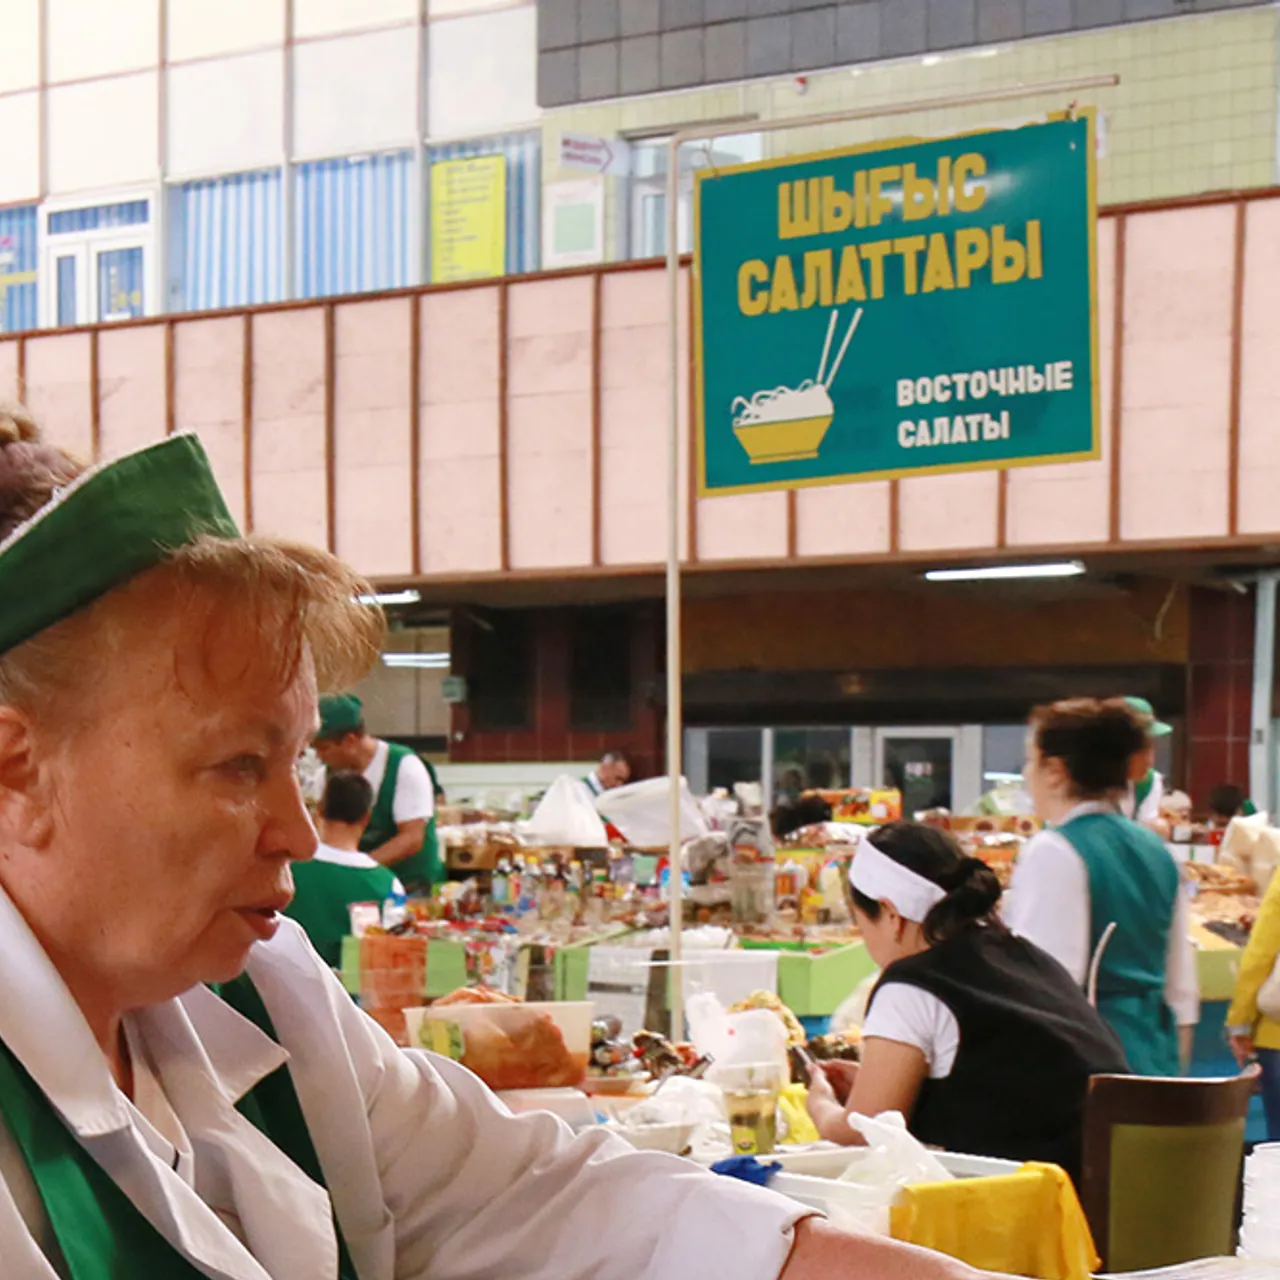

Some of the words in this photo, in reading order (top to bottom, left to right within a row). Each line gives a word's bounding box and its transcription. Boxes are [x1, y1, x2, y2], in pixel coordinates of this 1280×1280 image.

[777, 152, 987, 240] ШЫҒЫС
[737, 219, 1044, 317] САЛАТТАРЫ
[896, 360, 1074, 408] ВОСТОЧНЫЕ
[897, 410, 1011, 449] САЛАТЫ
